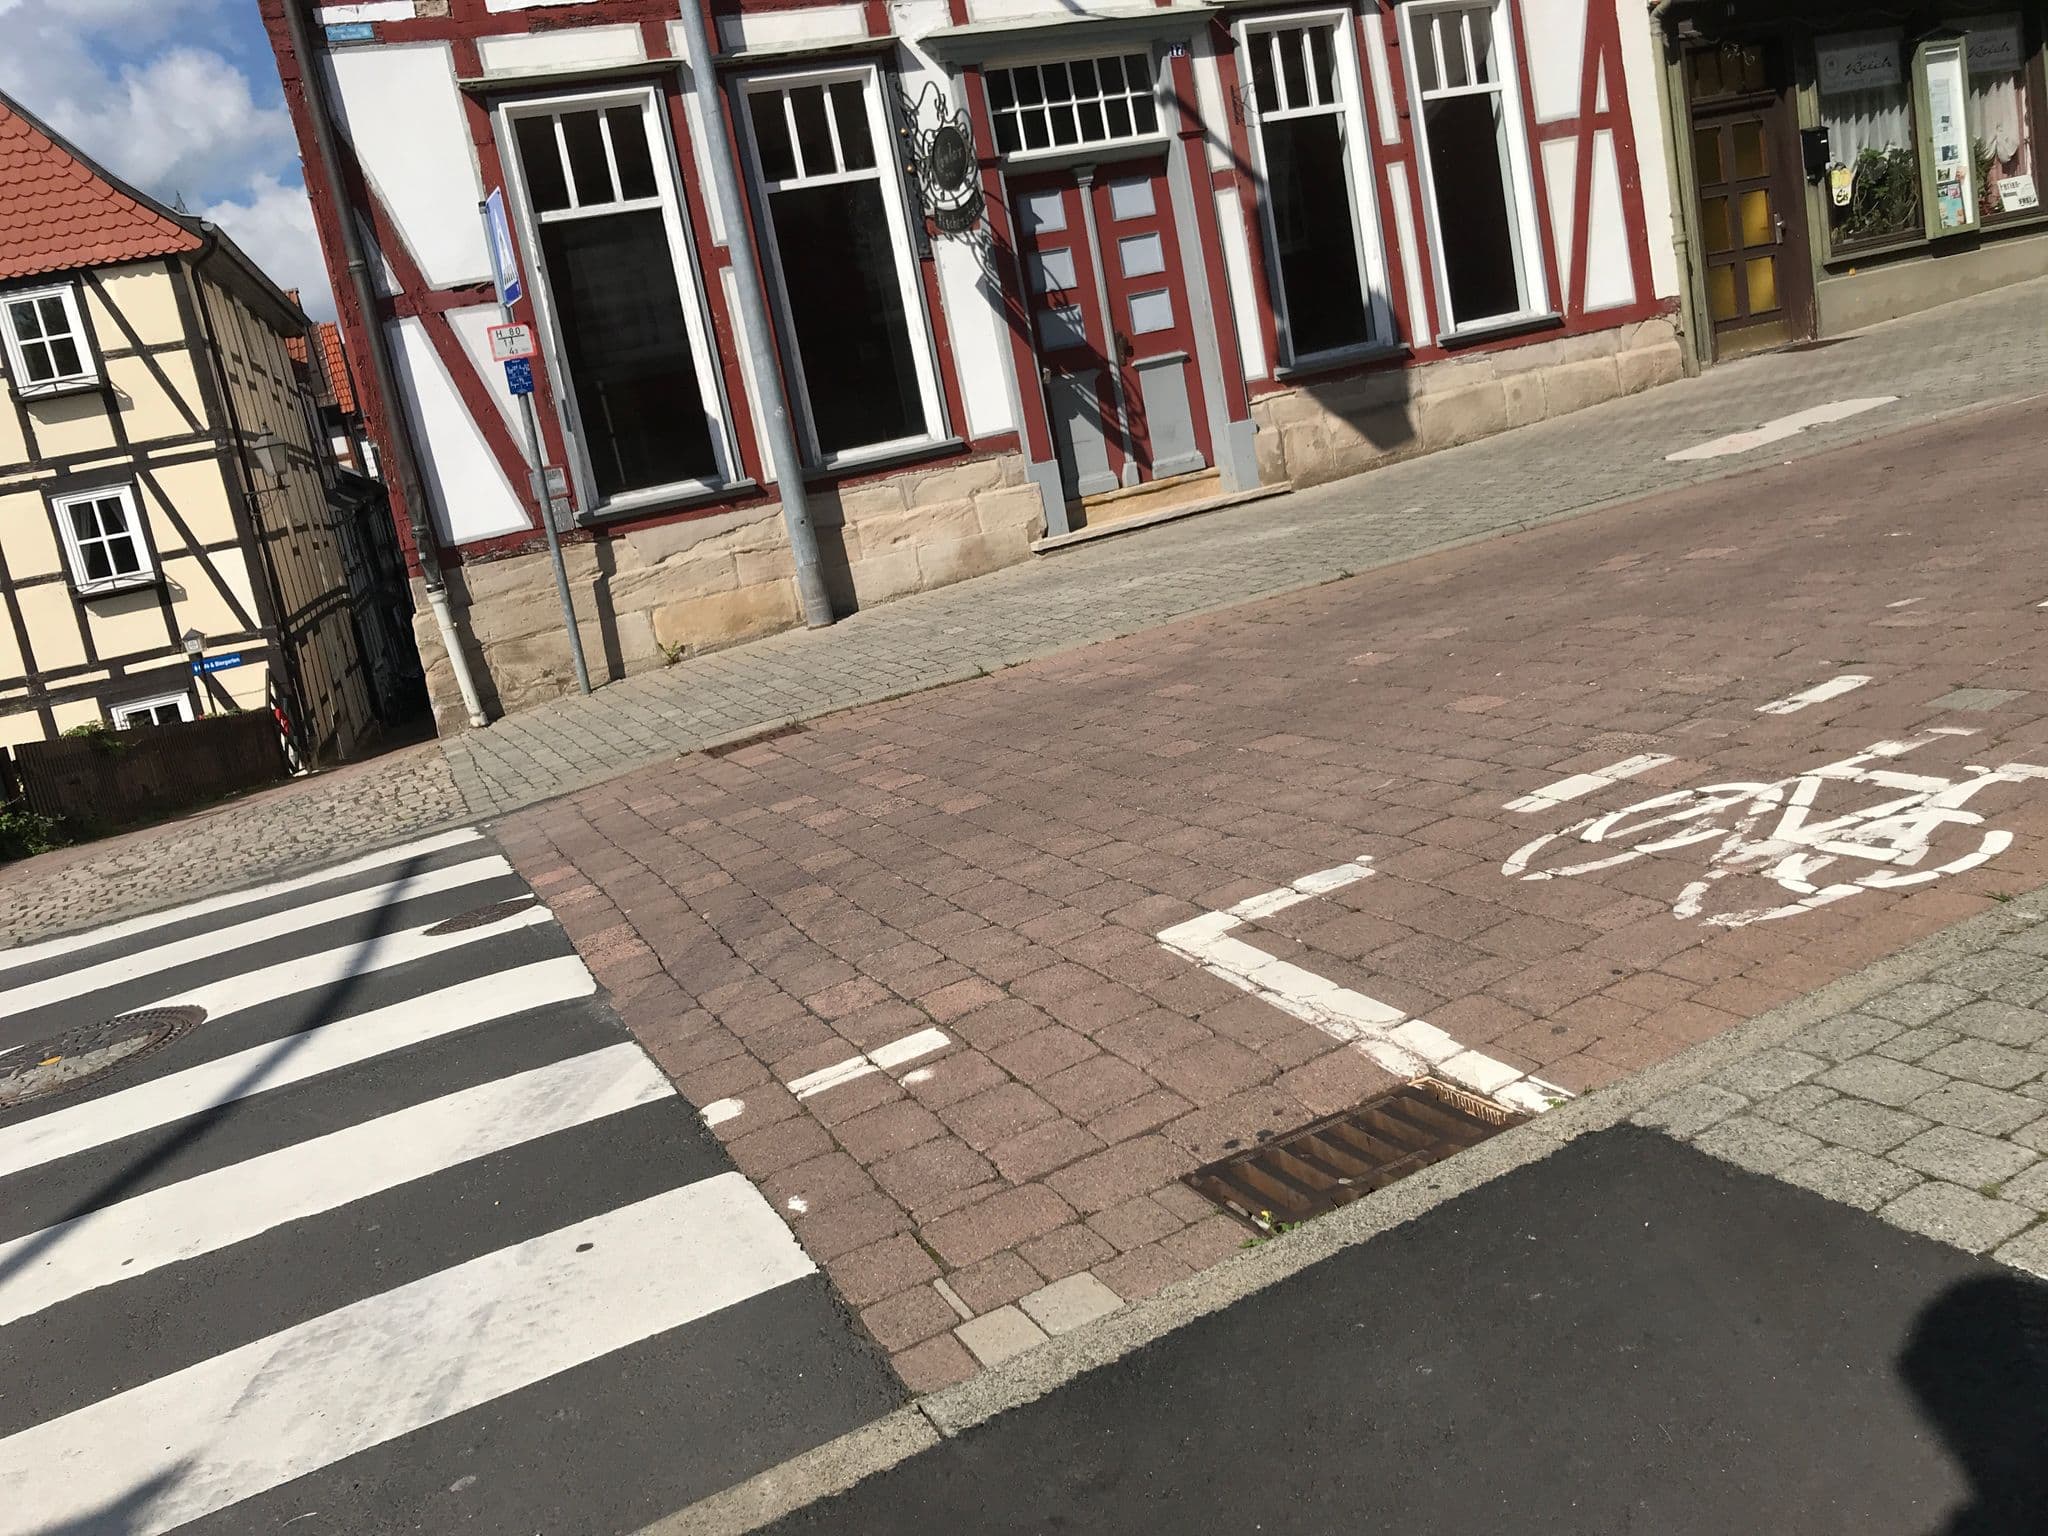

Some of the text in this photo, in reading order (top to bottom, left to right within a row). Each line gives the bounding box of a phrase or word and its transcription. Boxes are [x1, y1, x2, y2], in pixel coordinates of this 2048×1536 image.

[495, 326, 521, 338] H 80
[215, 657, 241, 667] Biergarten
